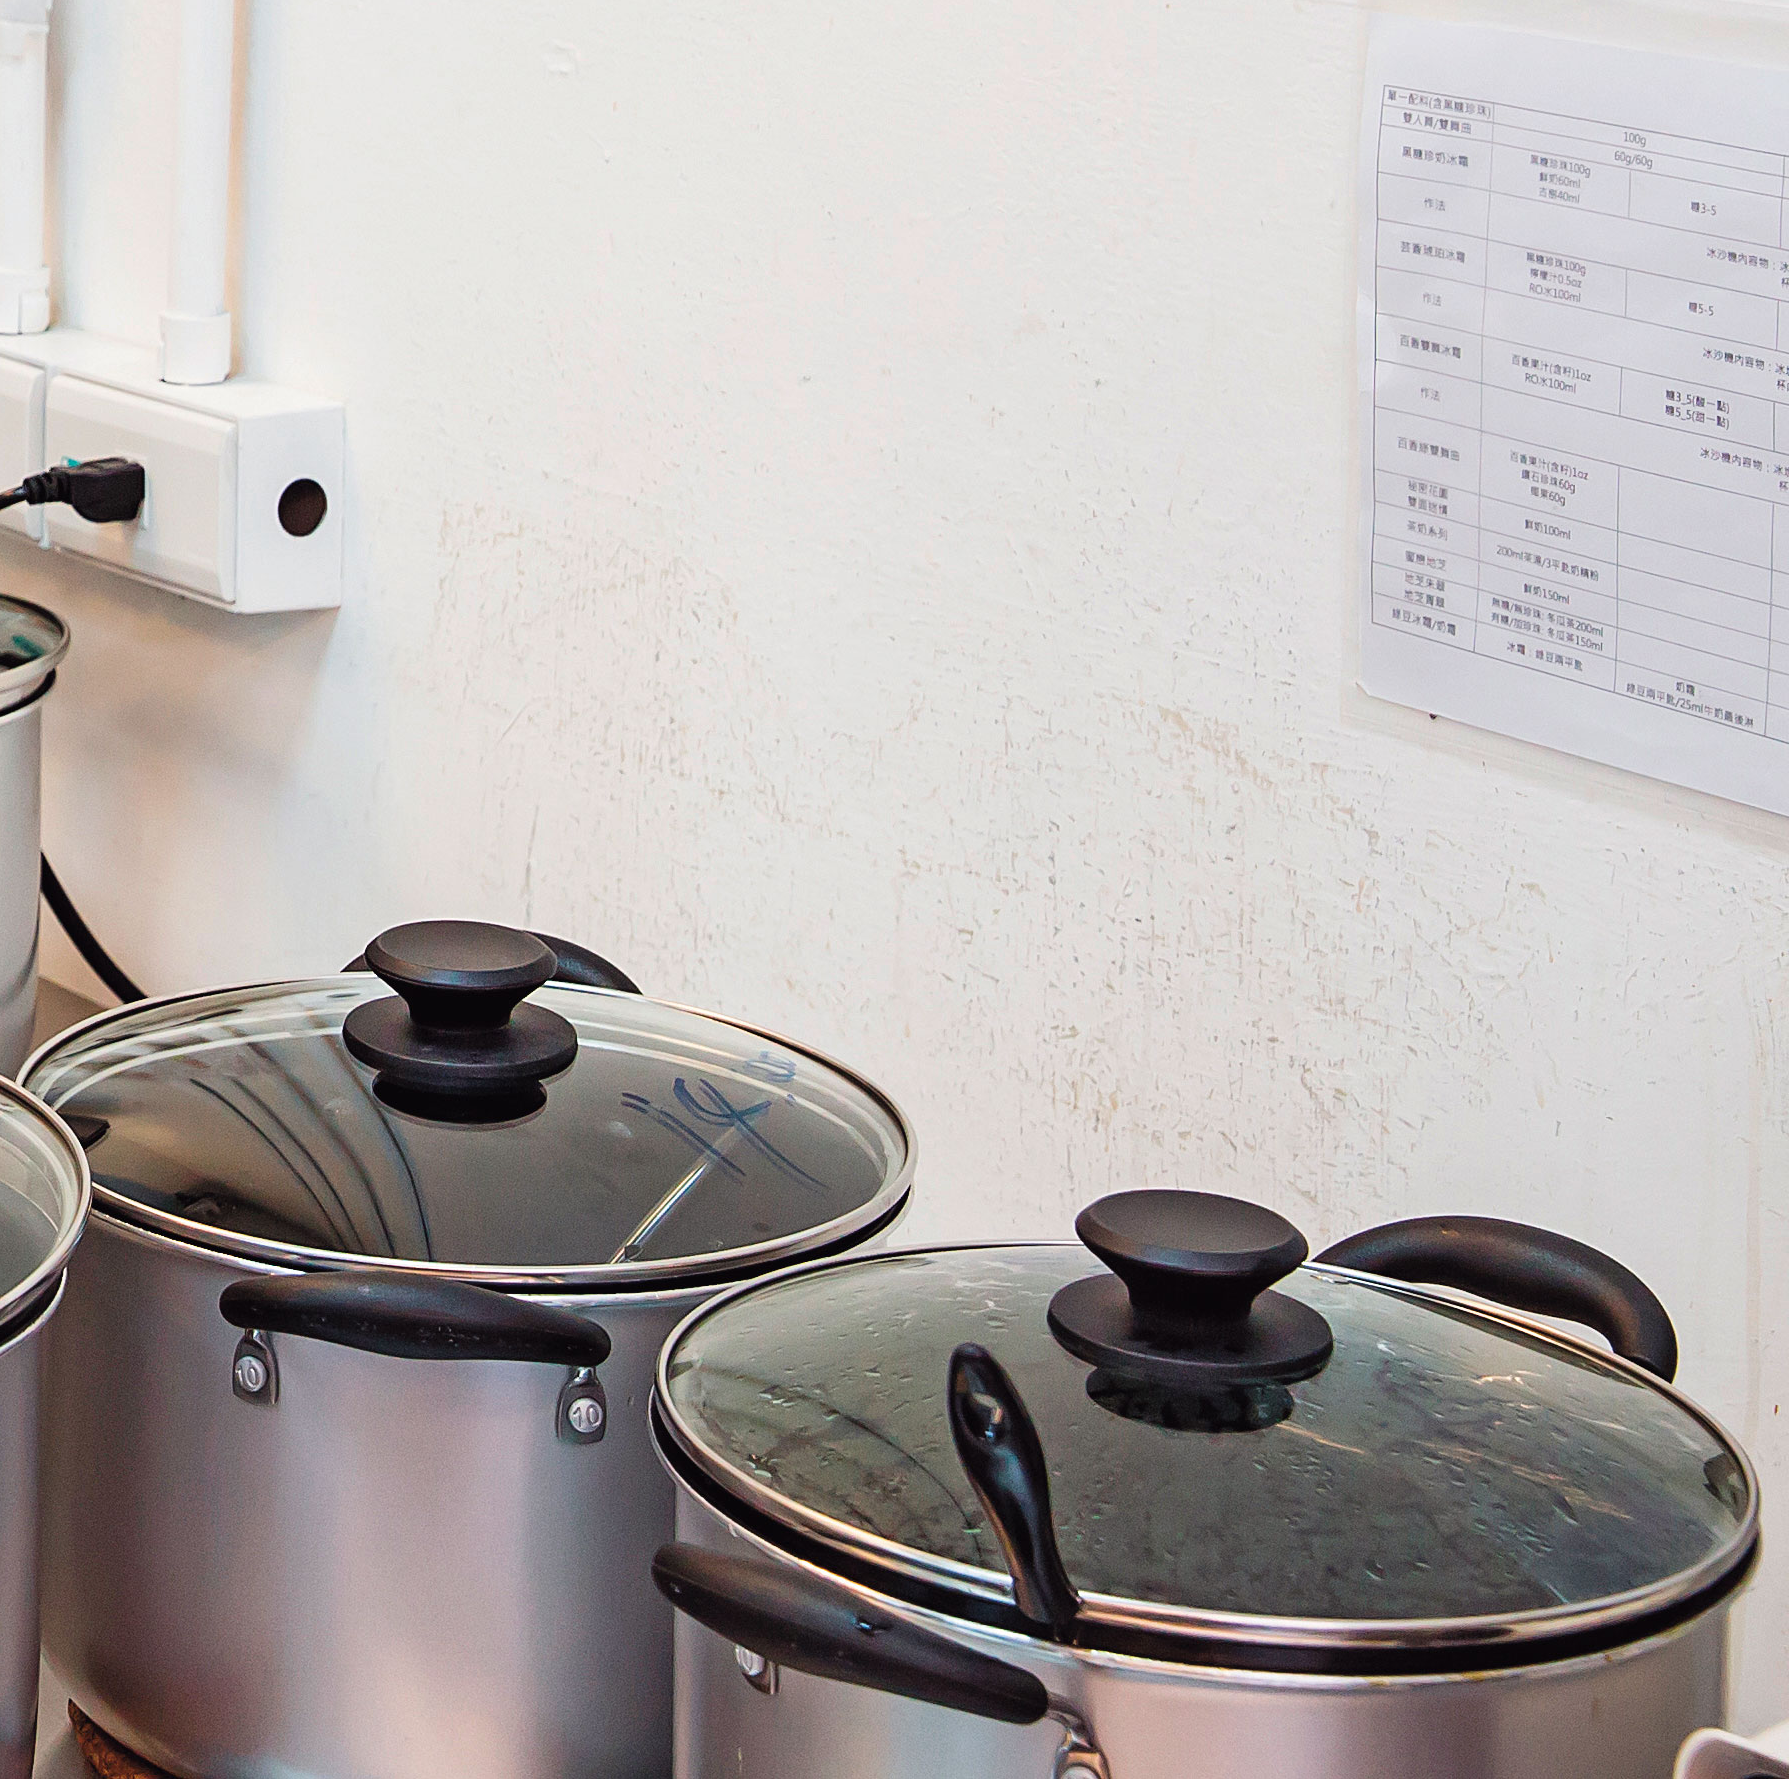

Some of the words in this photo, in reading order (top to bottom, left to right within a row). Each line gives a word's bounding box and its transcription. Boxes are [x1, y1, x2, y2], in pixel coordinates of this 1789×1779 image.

[1623, 131, 1647, 147] 100g
[1614, 151, 1653, 169] 60g/60g
[1424, 198, 1445, 211] 作法
[1422, 292, 1441, 307] 作法
[1421, 387, 1440, 402] 作法
[572, 1402, 602, 1429] 10
